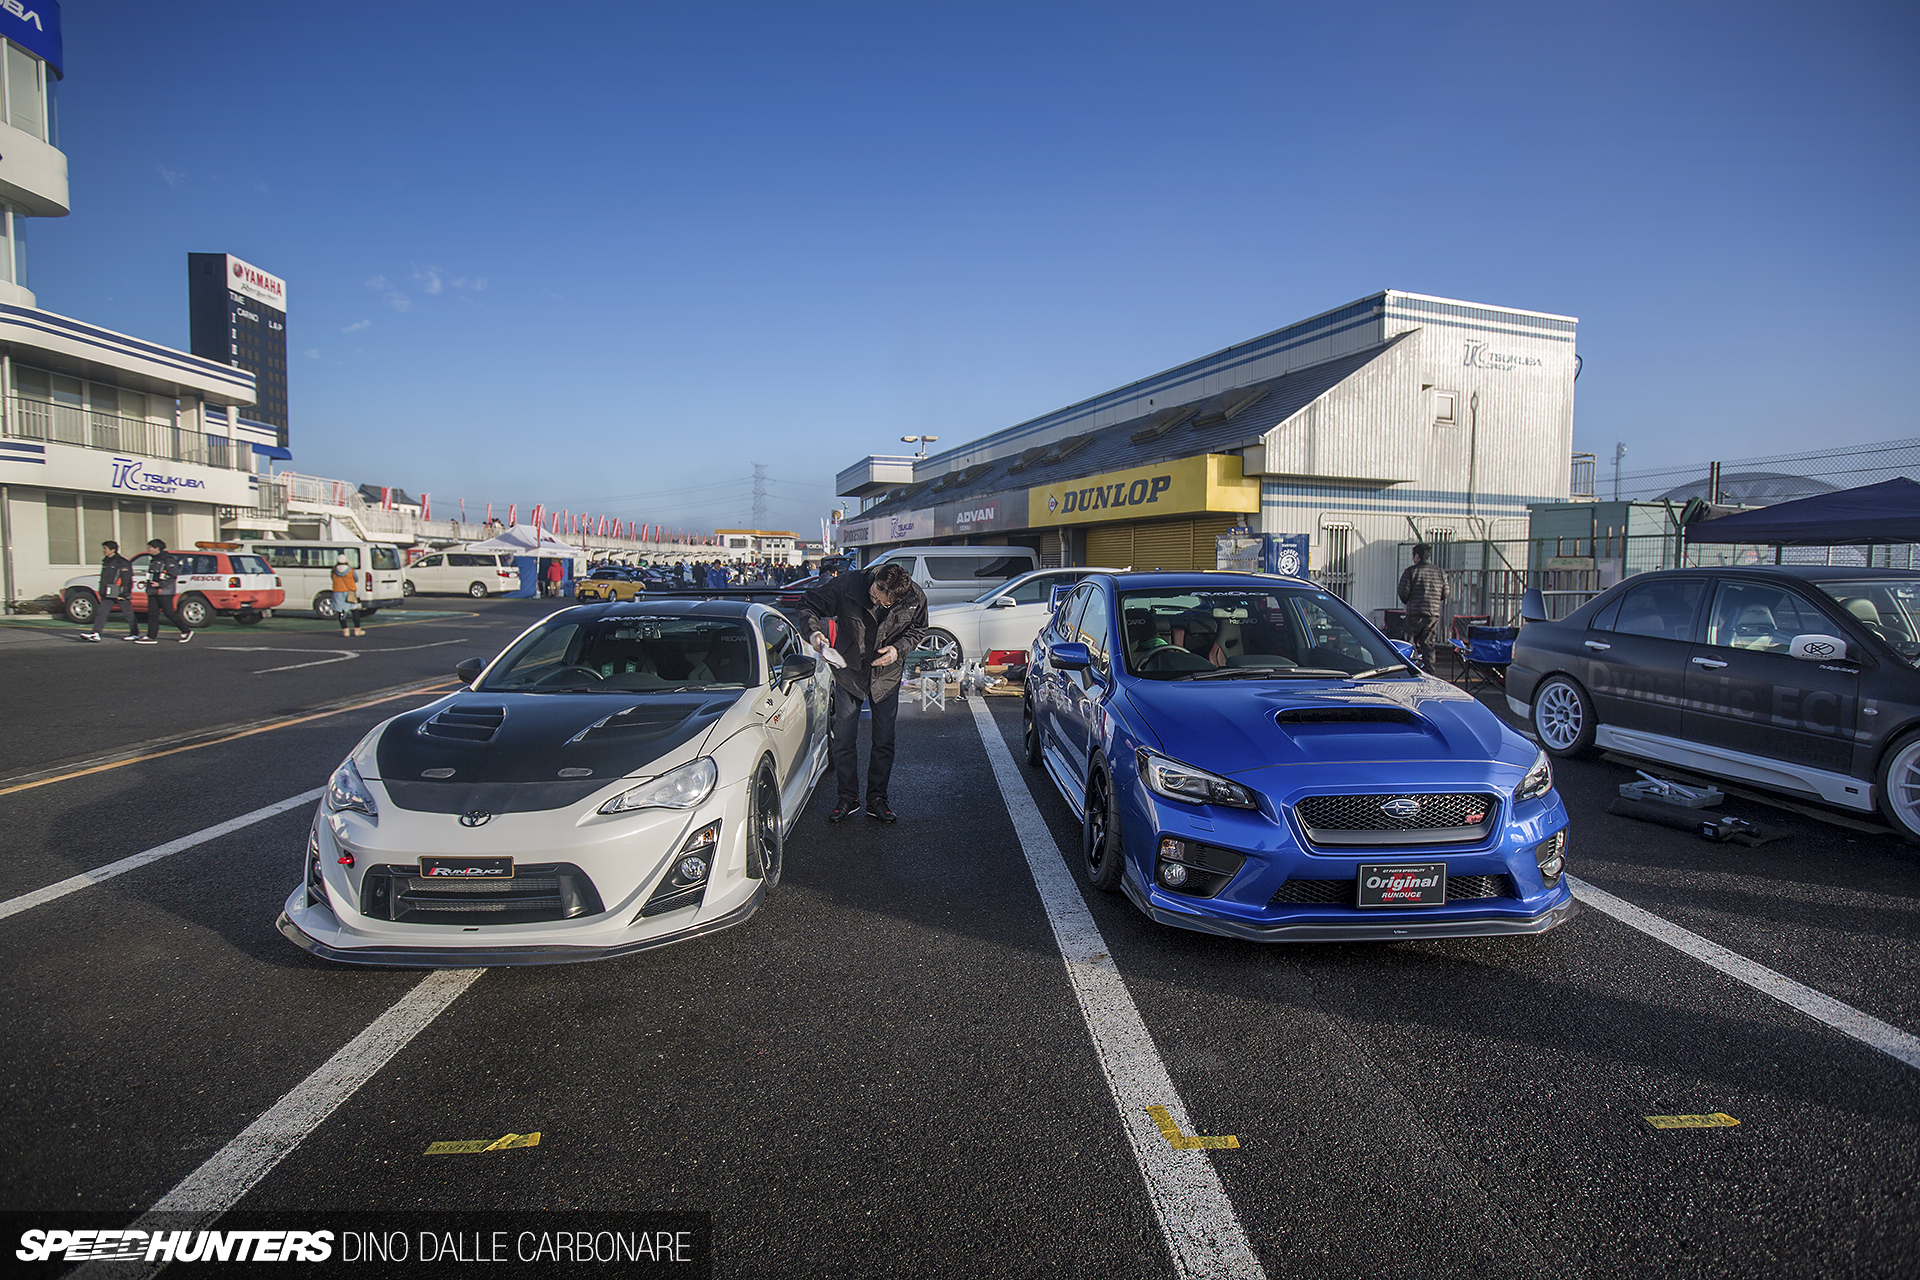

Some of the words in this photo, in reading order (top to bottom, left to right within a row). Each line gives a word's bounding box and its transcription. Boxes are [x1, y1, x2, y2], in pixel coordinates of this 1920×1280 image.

[244, 266, 283, 297] YAMAHA
[139, 483, 178, 494] CIRCUIT
[142, 472, 206, 490] TSUKUBA
[1061, 475, 1171, 514] DUNLOP
[956, 507, 995, 524] ADVAN
[843, 526, 869, 543] BRIDGESTONE
[1280, 549, 1299, 558] COFFEE
[1770, 684, 1879, 740] ECU
[1366, 875, 1440, 892] Original
[1381, 891, 1423, 899] RUNDUCE
